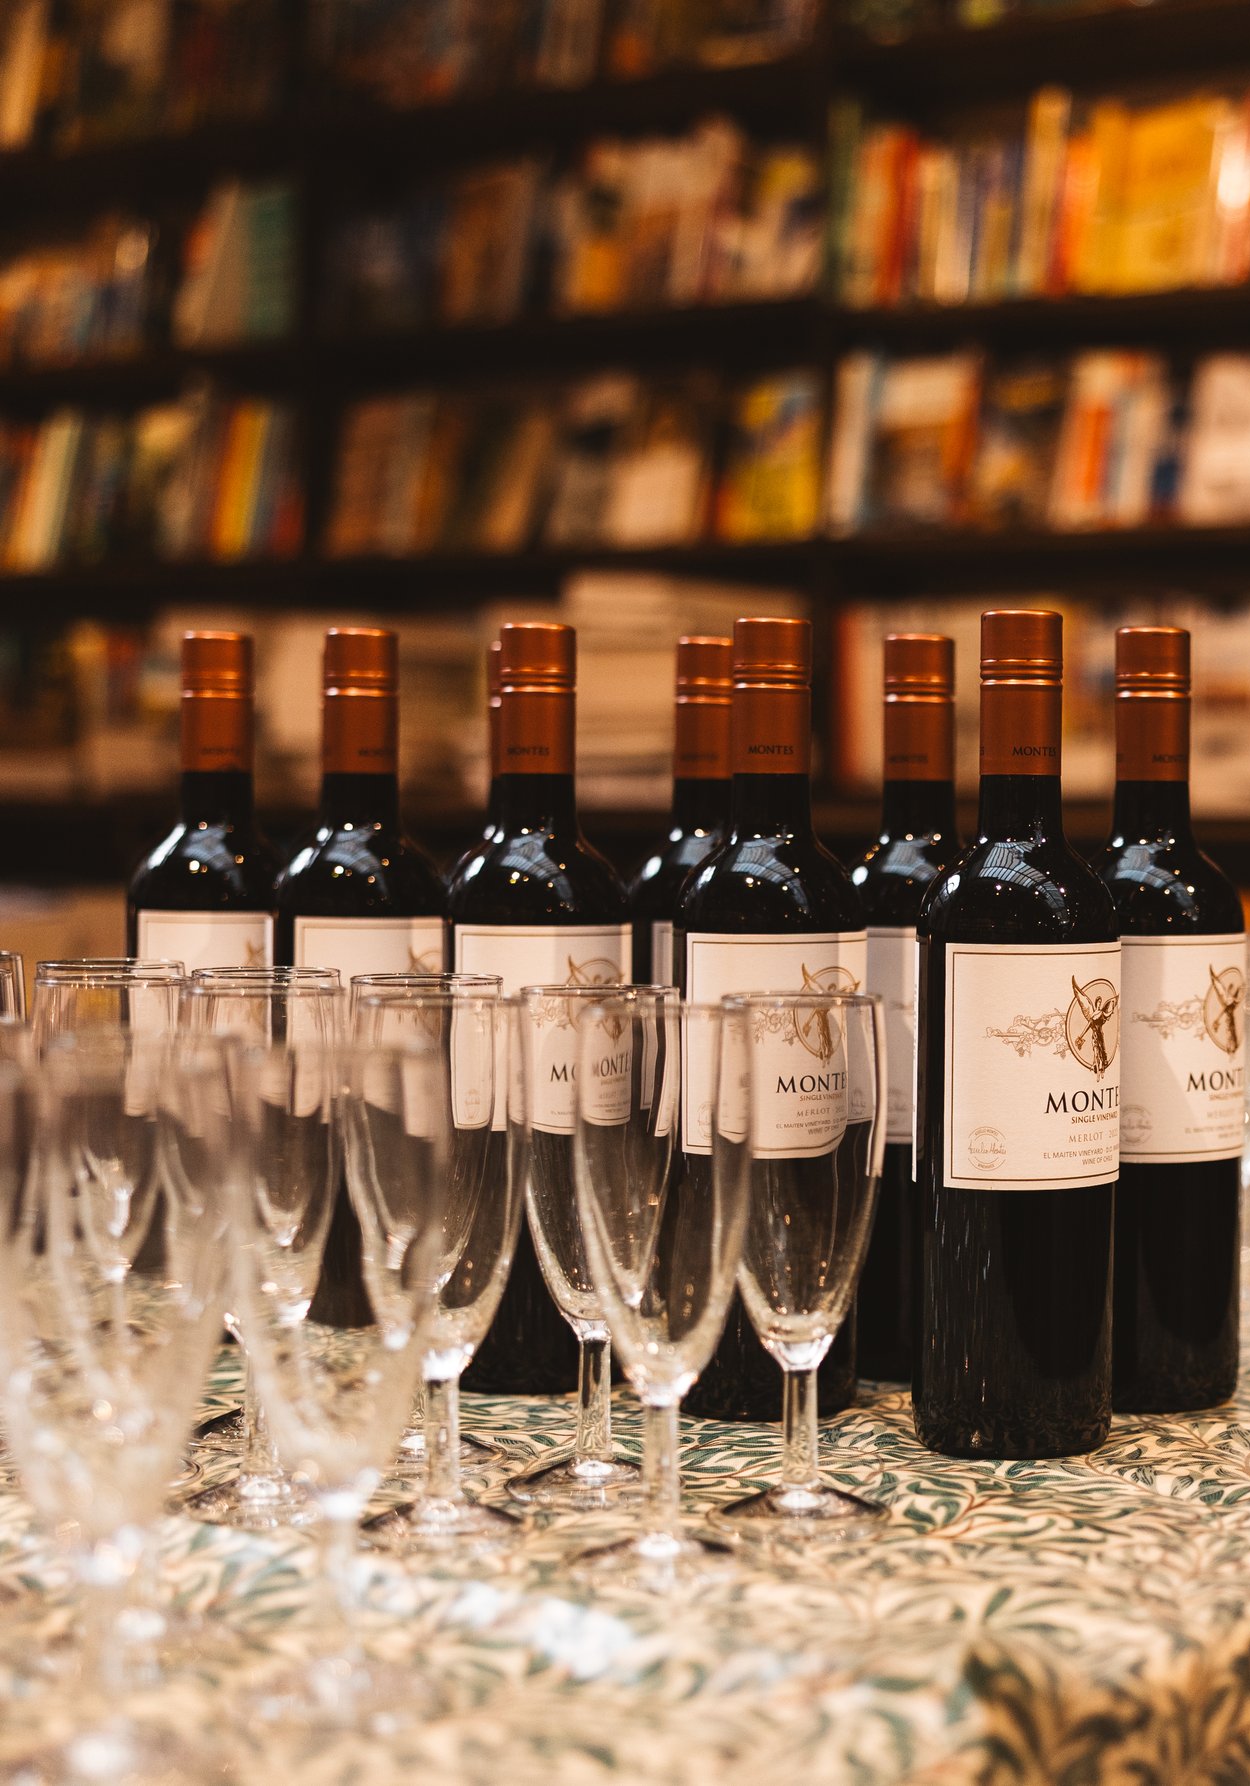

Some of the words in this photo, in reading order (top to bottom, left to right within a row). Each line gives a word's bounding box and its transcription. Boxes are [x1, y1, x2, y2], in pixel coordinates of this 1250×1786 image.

[747, 744, 794, 755] MONTES
[1011, 745, 1057, 757] MONTES
[592, 1050, 631, 1077] MONTE
[776, 1071, 847, 1094] MONTE
[1186, 1067, 1243, 1092] MONT
[1044, 1085, 1119, 1114] MONTE
[796, 1107, 830, 1118] MERLOT
[1071, 1114, 1096, 1124] SINGLE
[1068, 1131, 1104, 1143] MERLOT
[1043, 1152, 1051, 1160] EL
[1052, 1151, 1077, 1159] MAITEN
[1077, 1147, 1103, 1157] VINEYARD
[1082, 1157, 1096, 1165] WINE
